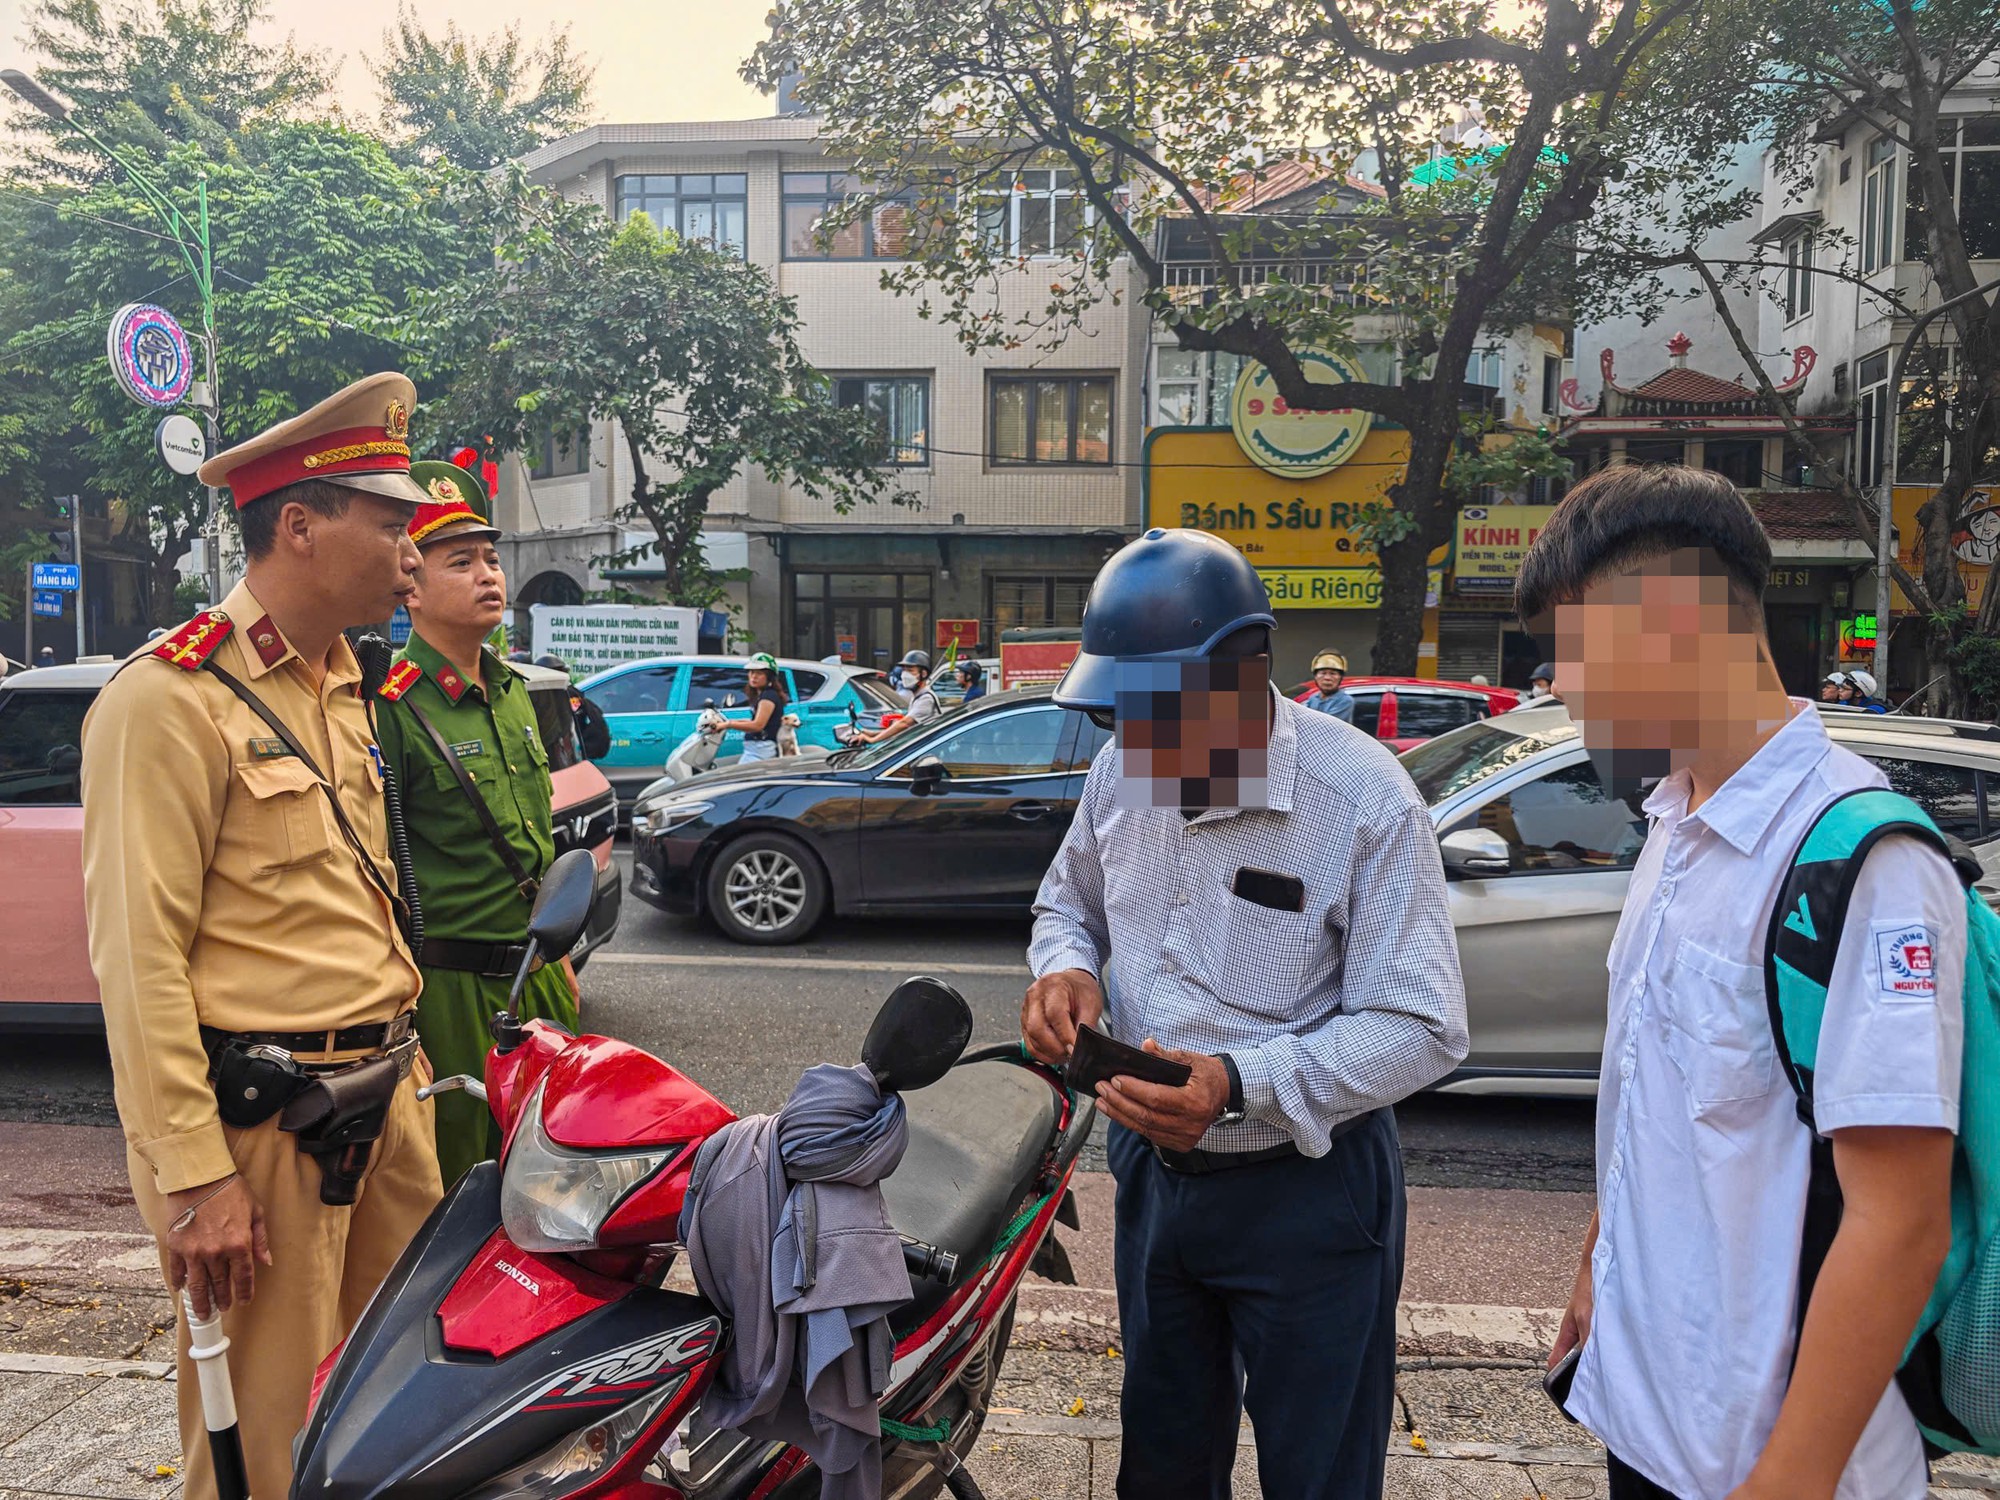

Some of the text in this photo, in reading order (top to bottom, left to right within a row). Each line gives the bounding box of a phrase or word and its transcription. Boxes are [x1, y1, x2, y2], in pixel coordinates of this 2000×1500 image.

[1247, 399, 1264, 416] 9
[165, 441, 203, 456] Vietcombank
[1181, 502, 1255, 529] Bánh
[1266, 497, 1322, 529] Sầu
[1464, 524, 1520, 546] KÍNH
[495, 1259, 540, 1297] HONDA
